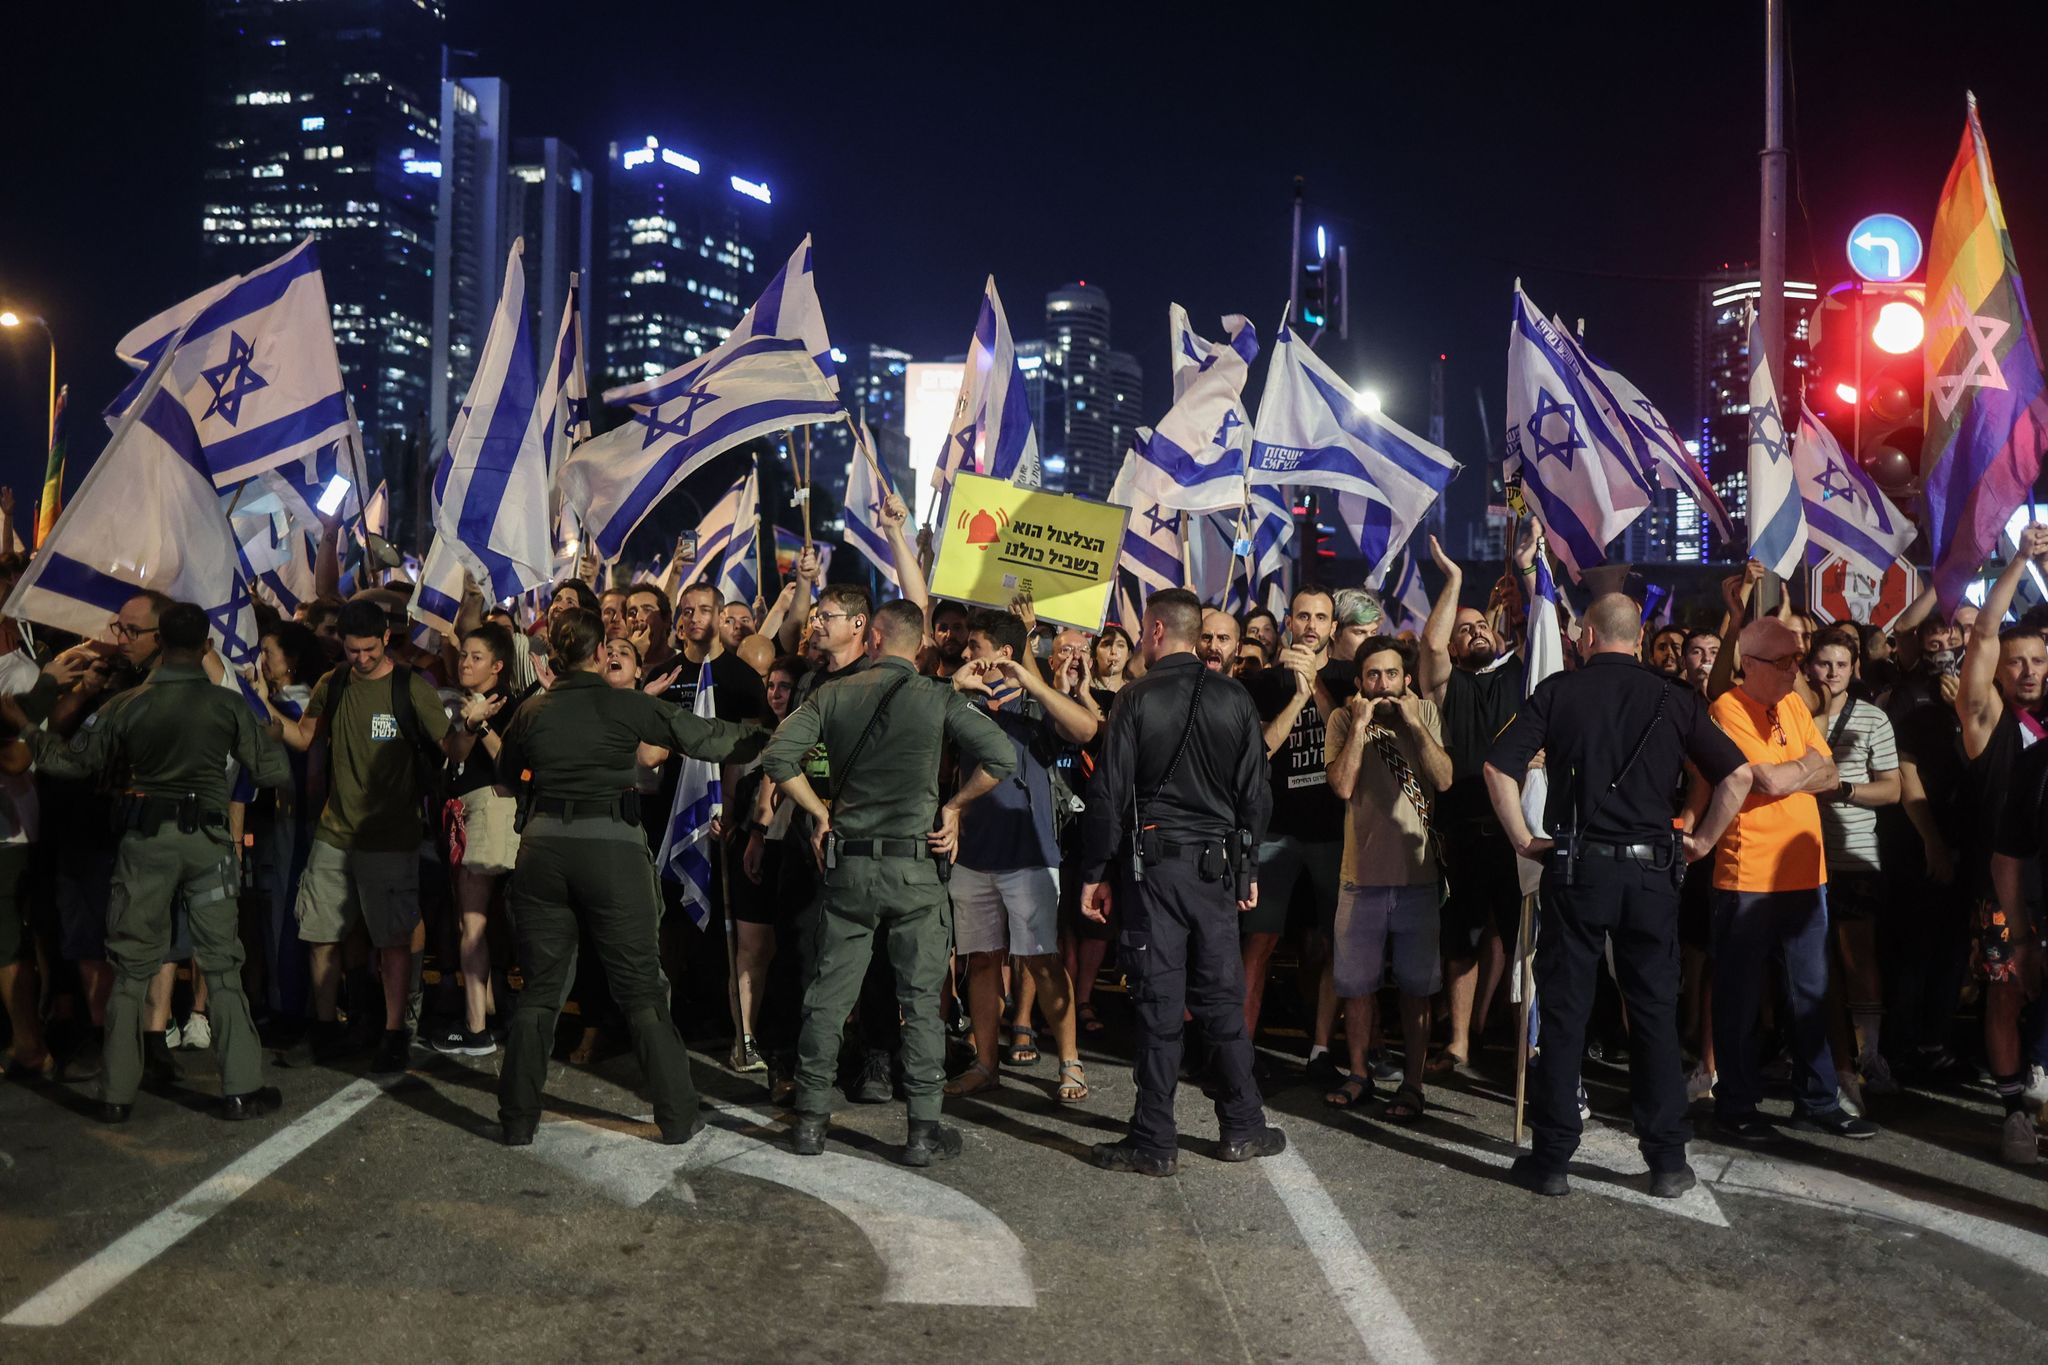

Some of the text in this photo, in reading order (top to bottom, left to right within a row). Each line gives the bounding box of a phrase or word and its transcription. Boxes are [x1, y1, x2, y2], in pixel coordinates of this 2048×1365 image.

[1012, 520, 1105, 553] הצלצול הוא
[1004, 541, 1099, 575] בשביל כולנו
[371, 720, 391, 731] אחים
[371, 728, 397, 738] לנשק
[1292, 746, 1325, 769] הלכה
